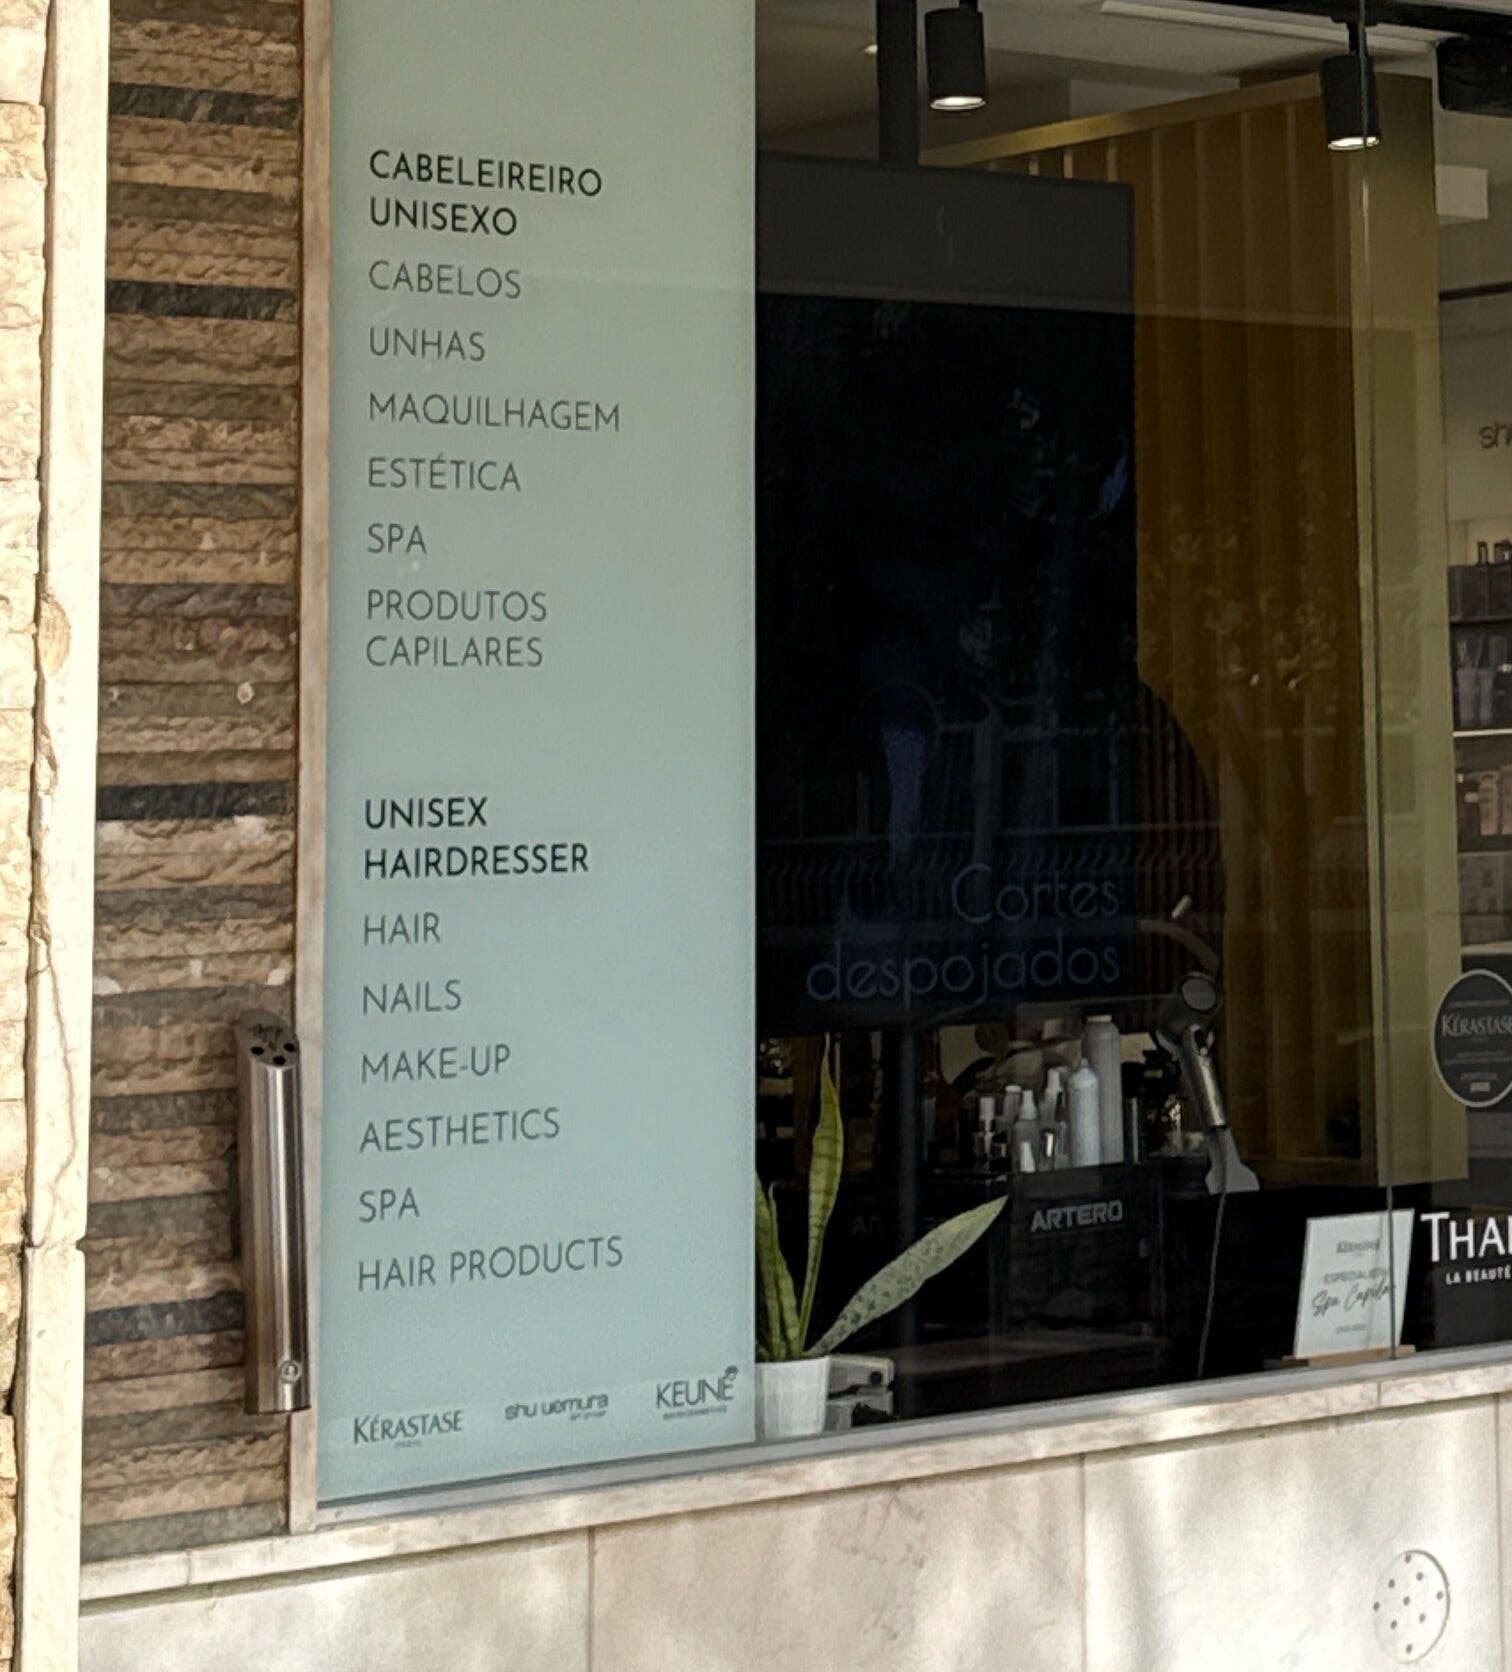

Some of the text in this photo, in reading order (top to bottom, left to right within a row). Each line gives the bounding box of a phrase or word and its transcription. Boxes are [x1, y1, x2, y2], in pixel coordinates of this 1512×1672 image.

[370, 150, 602, 197] CABELEIREIRO
[370, 197, 517, 236] UNISEXO
[369, 260, 521, 299] CABELOS
[369, 327, 486, 362] UNHAS
[369, 393, 620, 432] MAQUILHAGEM
[368, 452, 521, 491] ESTÉTICA
[368, 523, 427, 554] SPA
[368, 588, 548, 622] PRODUTOS
[366, 636, 543, 668] CAPILARES
[366, 797, 488, 829] UNISEX
[365, 843, 589, 879] HAIRDRESSER
[951, 863, 1122, 923] Cortes
[363, 912, 441, 946] HAIR
[806, 926, 1122, 1014] despojados
[362, 980, 462, 1015] NAILS
[361, 1044, 511, 1083] MAKE-UP
[359, 1107, 561, 1154] AESTHETICS
[359, 1187, 420, 1223] SPA
[1030, 1199, 1124, 1233] ARTERO
[358, 1235, 623, 1292] HAIR PRODUCTS
[504, 1397, 538, 1421] shu
[540, 1392, 609, 1417] uemura
[353, 1409, 463, 1445] KÉRASTASE
